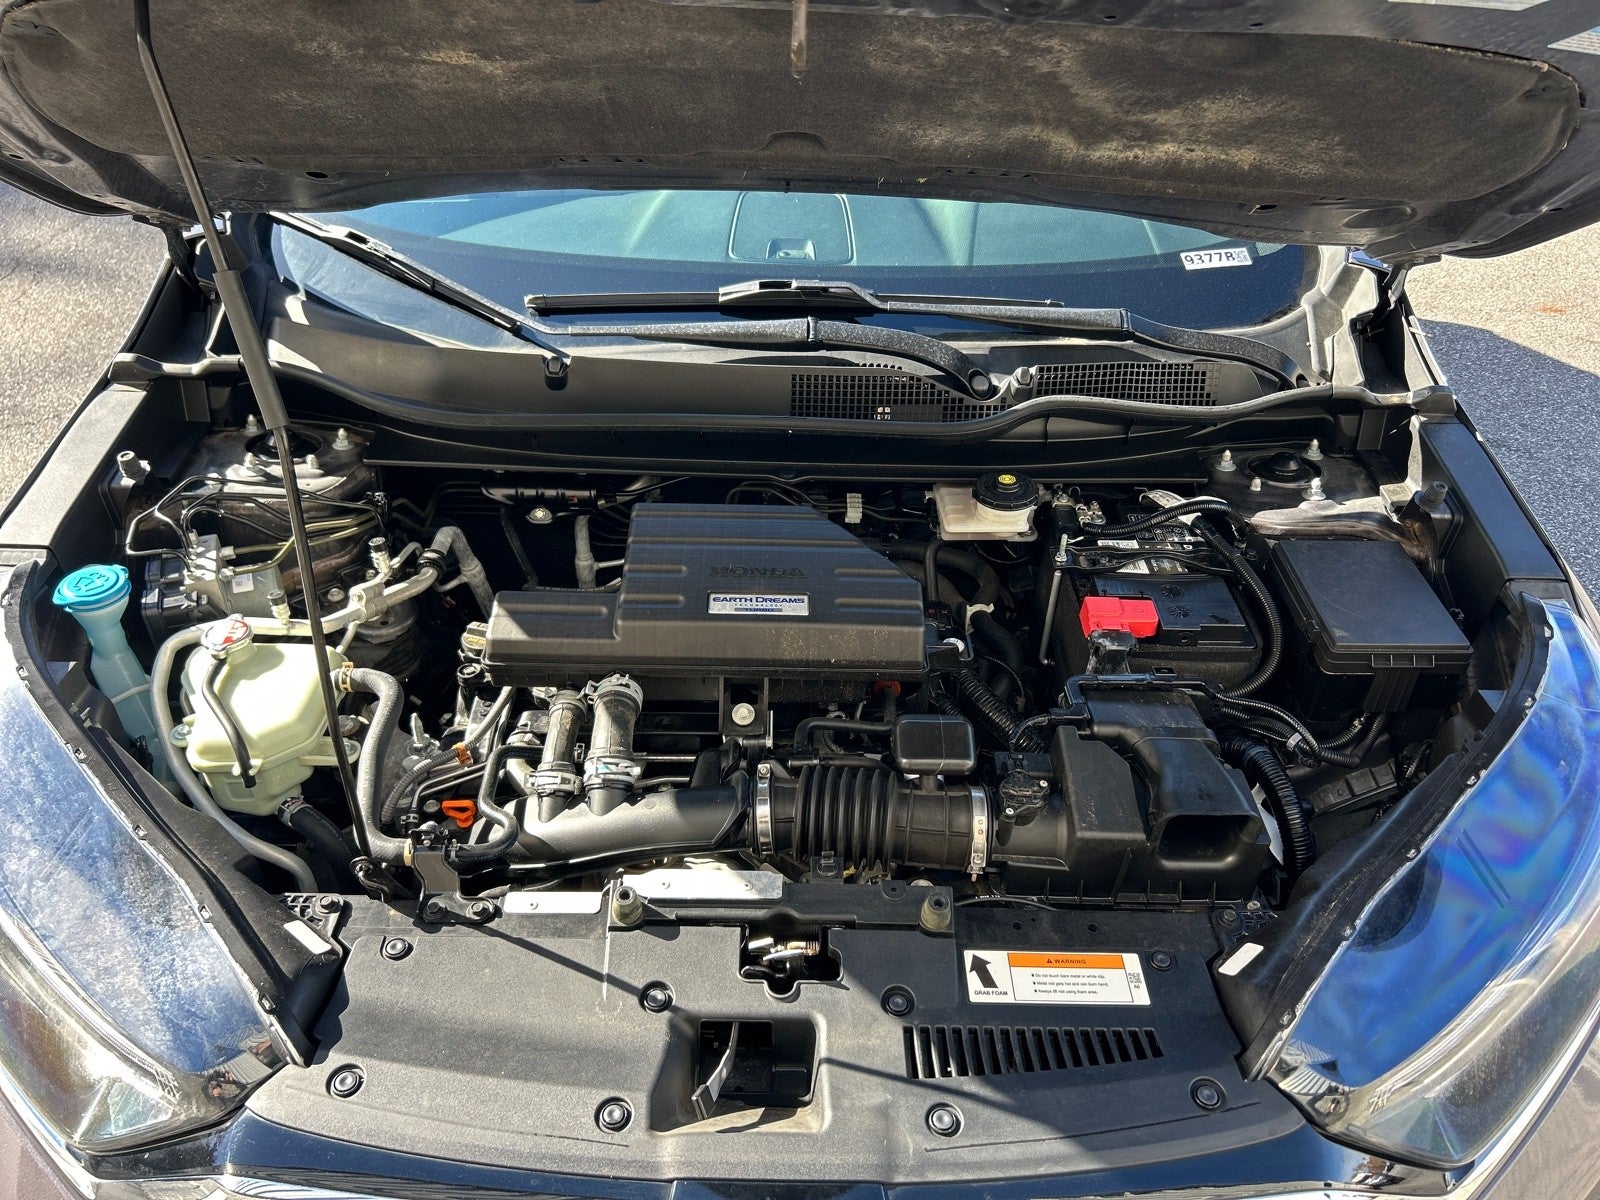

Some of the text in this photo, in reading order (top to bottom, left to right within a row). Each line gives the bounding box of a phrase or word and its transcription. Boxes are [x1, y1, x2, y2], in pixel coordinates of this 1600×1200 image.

[1184, 251, 1236, 265] 9377R
[708, 566, 808, 578] HONDA
[755, 596, 805, 604] DREAMS
